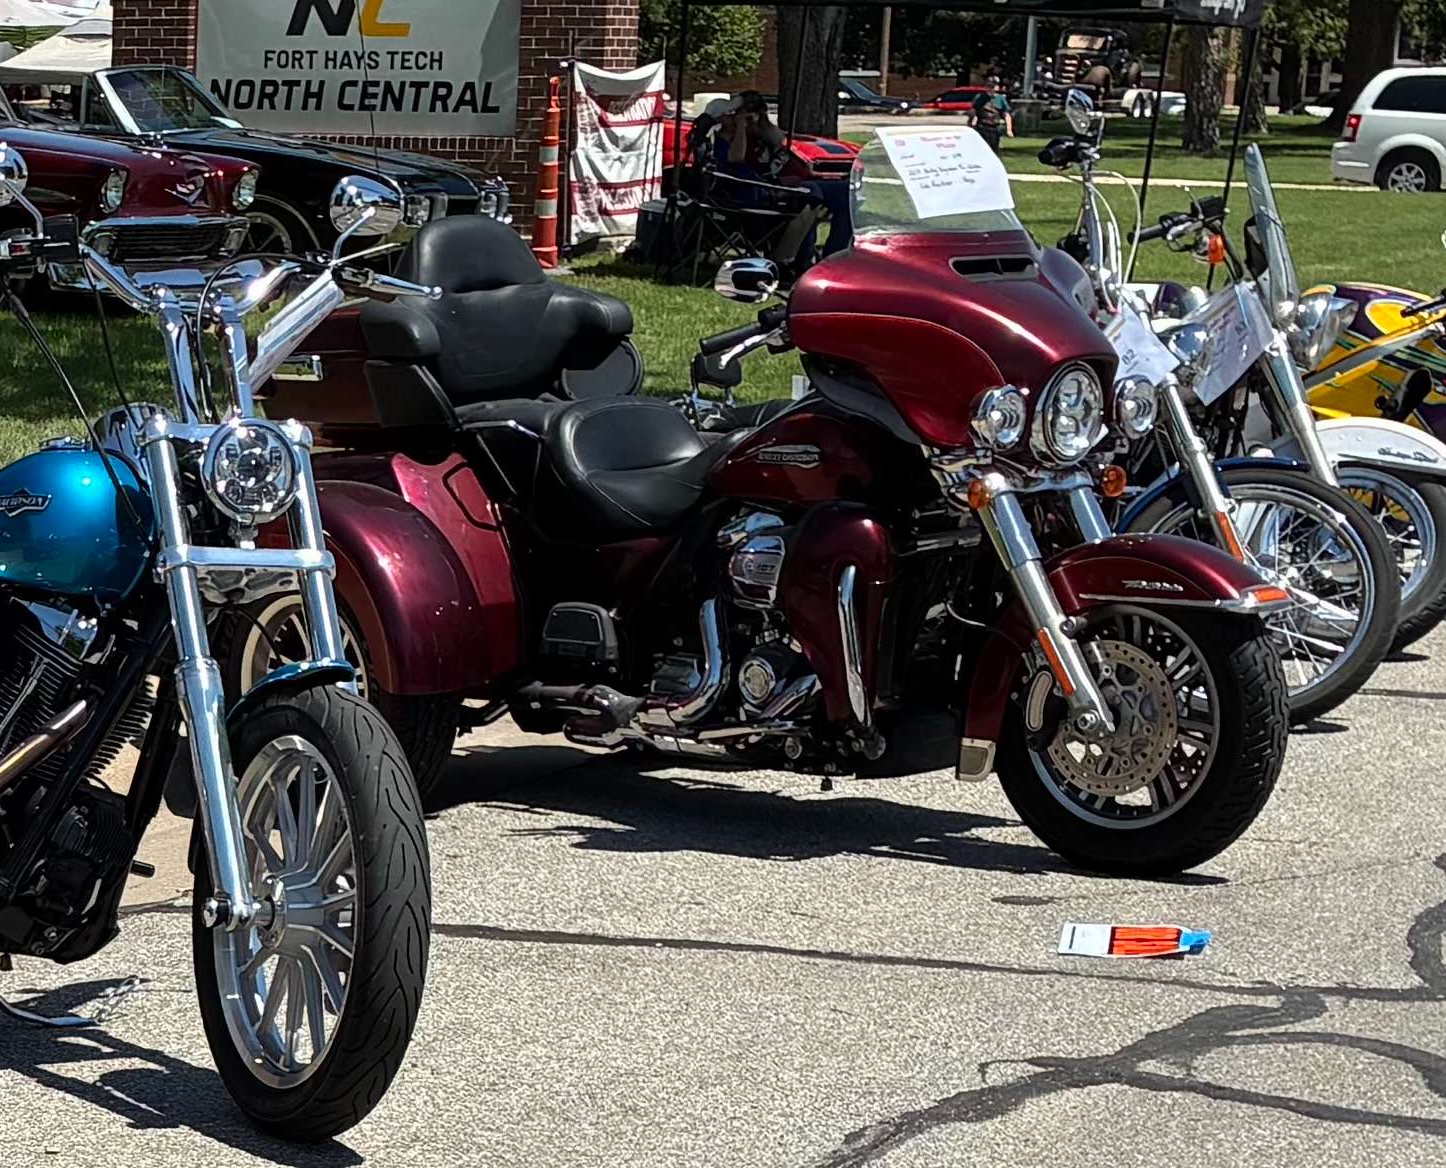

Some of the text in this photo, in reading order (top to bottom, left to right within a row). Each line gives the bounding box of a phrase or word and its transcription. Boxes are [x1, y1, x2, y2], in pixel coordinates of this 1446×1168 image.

[264, 50, 443, 71] FORT HAYS TECH
[210, 78, 501, 114] NORTH CENTRAL
